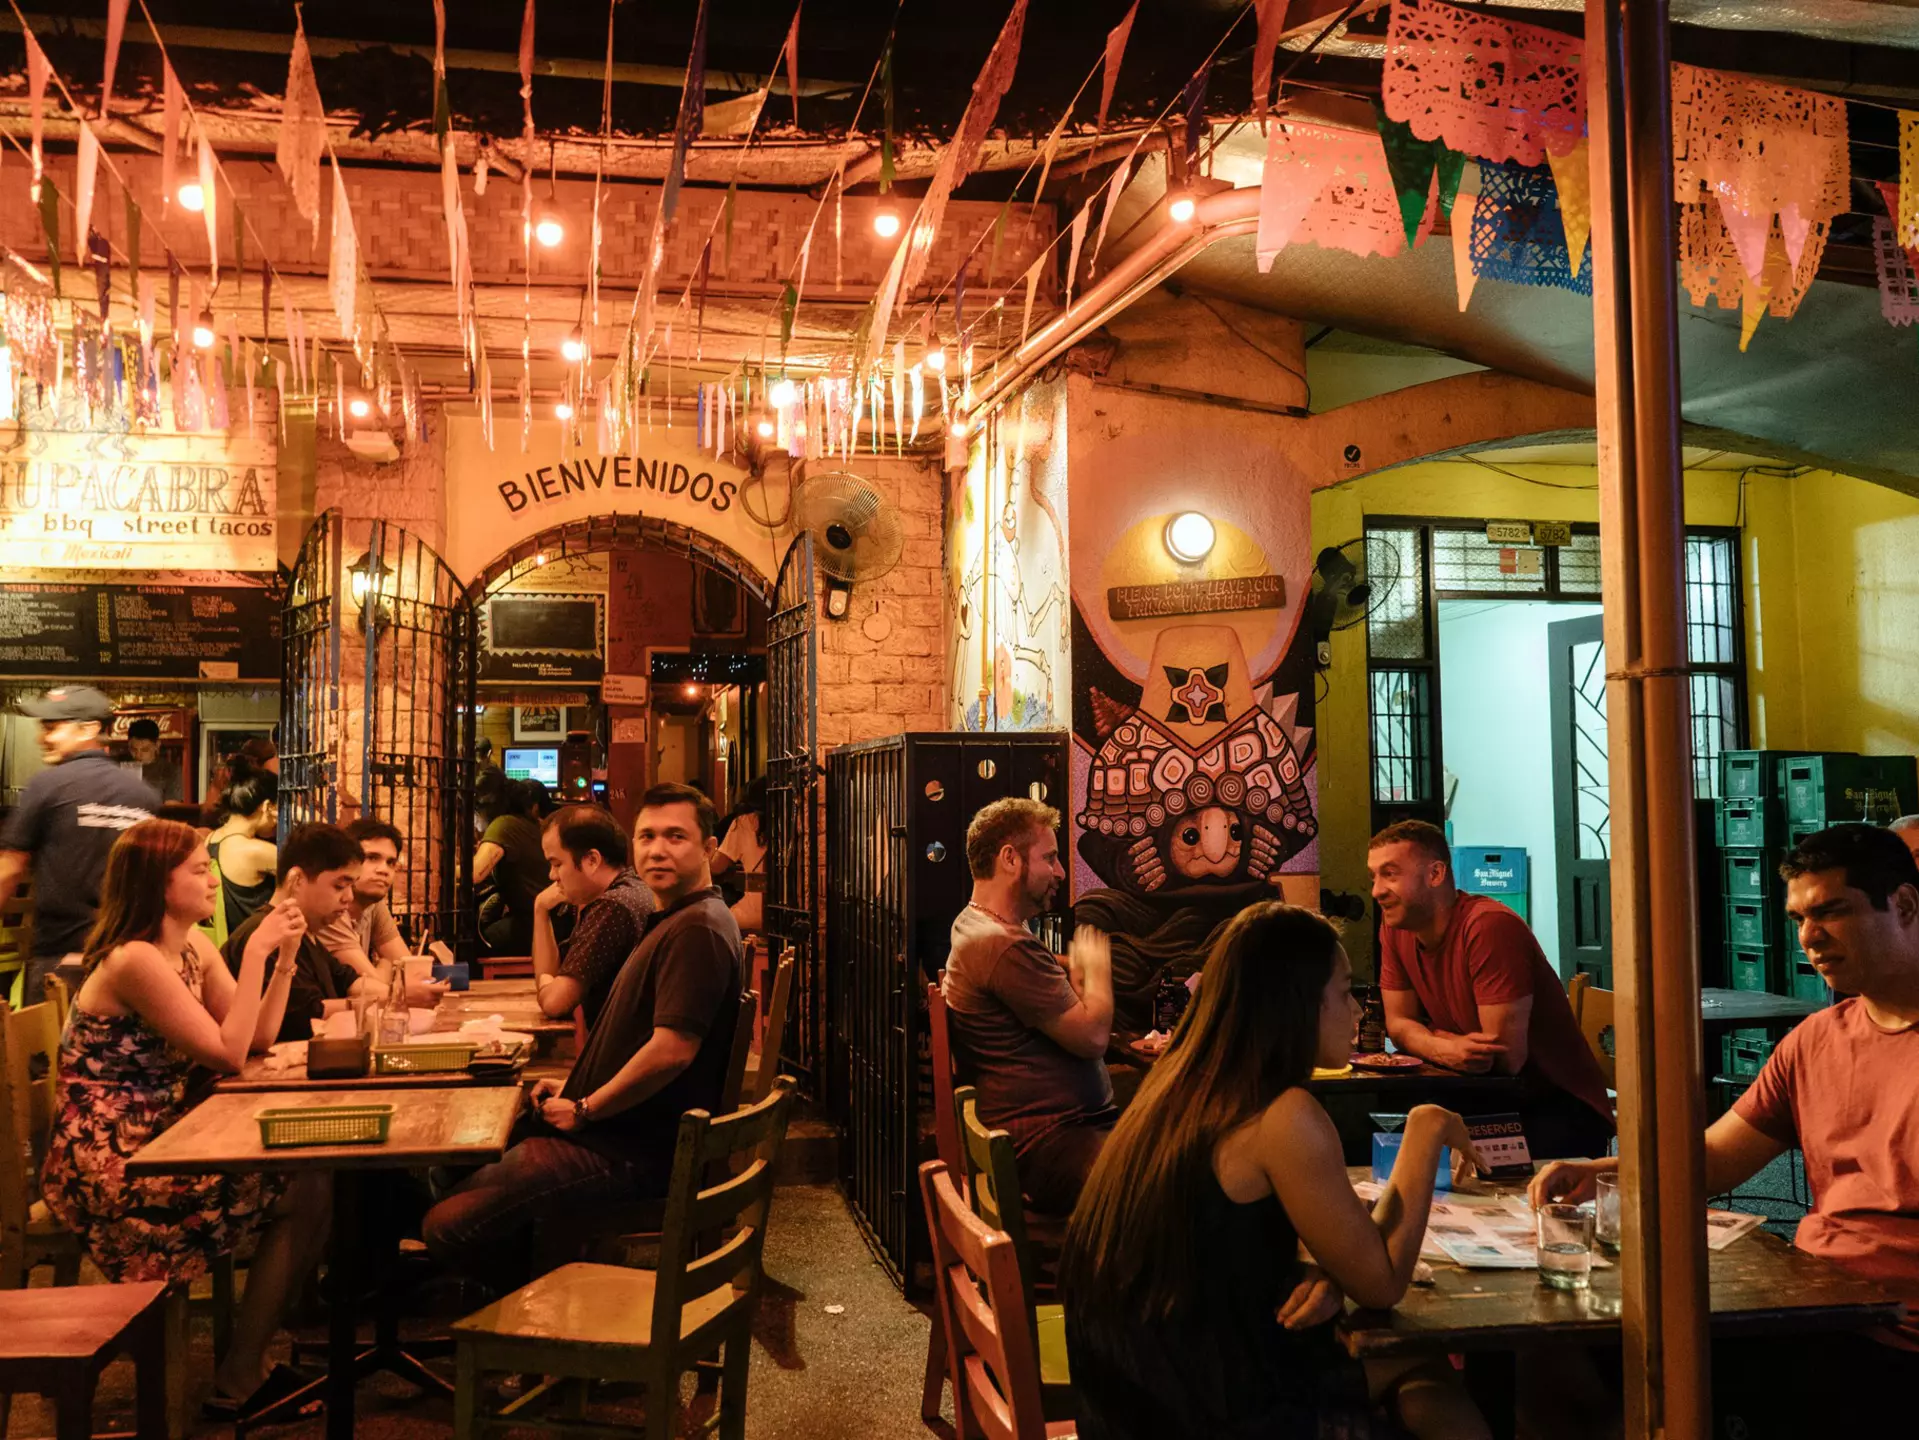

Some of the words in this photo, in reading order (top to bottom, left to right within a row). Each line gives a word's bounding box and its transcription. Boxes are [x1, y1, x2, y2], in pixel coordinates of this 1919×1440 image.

[498, 456, 737, 512] BIENVENIDOS
[43, 512, 94, 539] bbq
[123, 515, 200, 535] street
[209, 518, 273, 537] tacos
[1496, 527, 1521, 538] 5782
[1540, 528, 1565, 540] 5782
[1117, 586, 1160, 603] PLEASE
[1208, 579, 1245, 596] LEAVE
[1247, 577, 1280, 592] YOUR
[1127, 600, 1175, 618] THINGS
[1474, 868, 1488, 878] San
[1489, 868, 1513, 879] Miguel
[1469, 1123, 1522, 1135] RESERVED
